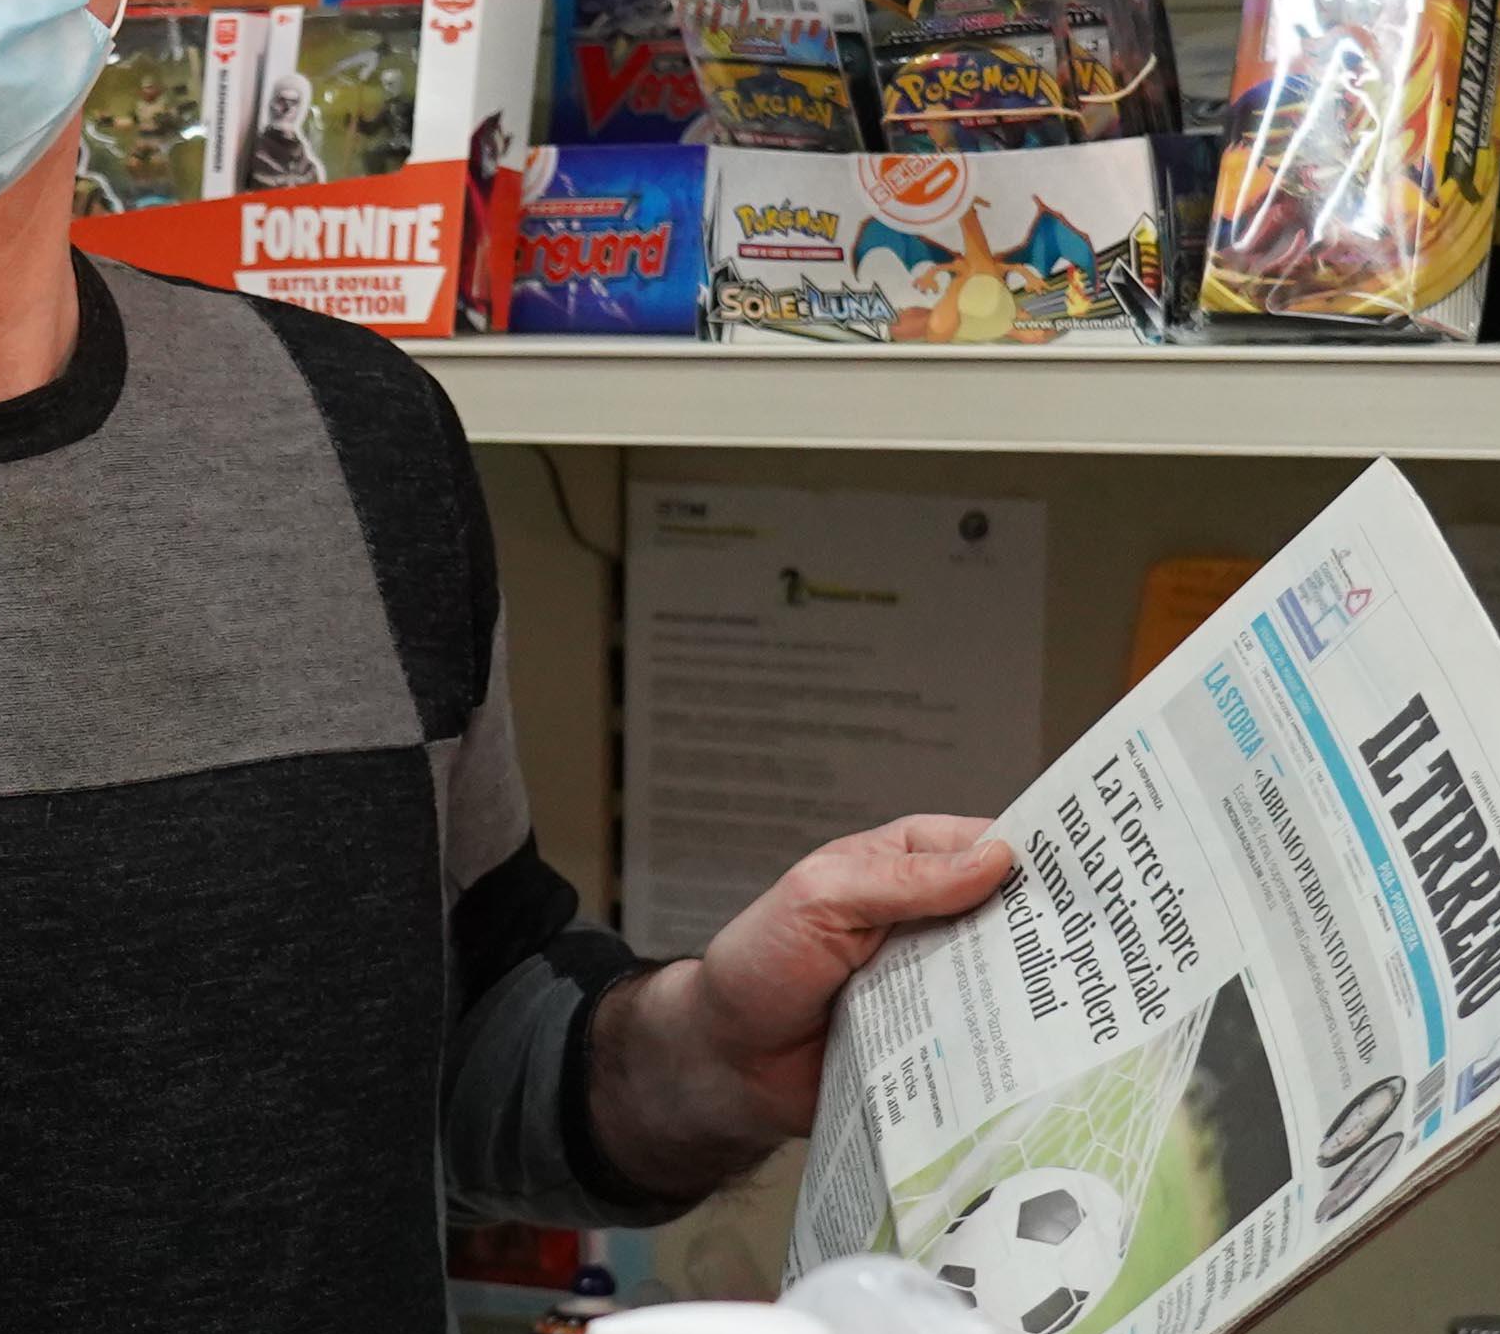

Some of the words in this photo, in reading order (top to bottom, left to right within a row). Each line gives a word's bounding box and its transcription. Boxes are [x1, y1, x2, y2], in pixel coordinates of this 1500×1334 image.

[241, 203, 444, 265] FORTNITE
[268, 277, 331, 293] BATTLE
[335, 276, 403, 294] ROYALE
[1201, 661, 1235, 702] LA
[1213, 686, 1266, 762] STORIA
[1356, 692, 1446, 799] IL
[1089, 754, 1127, 805] La
[1055, 794, 1094, 849] ma
[1106, 791, 1165, 889] Torre
[1023, 827, 1080, 915] stima
[1078, 837, 1112, 880] la
[1249, 766, 1303, 864] «ABBIAMO
[1290, 856, 1344, 971] PERDONATO
[1060, 905, 1098, 948] di
[1146, 874, 1204, 974] riapre
[1376, 860, 1397, 890] PISA
[1388, 889, 1420, 953] PONTEDERA
[1012, 926, 1065, 1022] milioni
[1090, 867, 1175, 1027] Primaziale
[1058, 939, 1128, 1048] perdere
[882, 1078, 898, 1100] 36
[884, 1094, 904, 1128] anni
[897, 1055, 921, 1102] Uccisa
